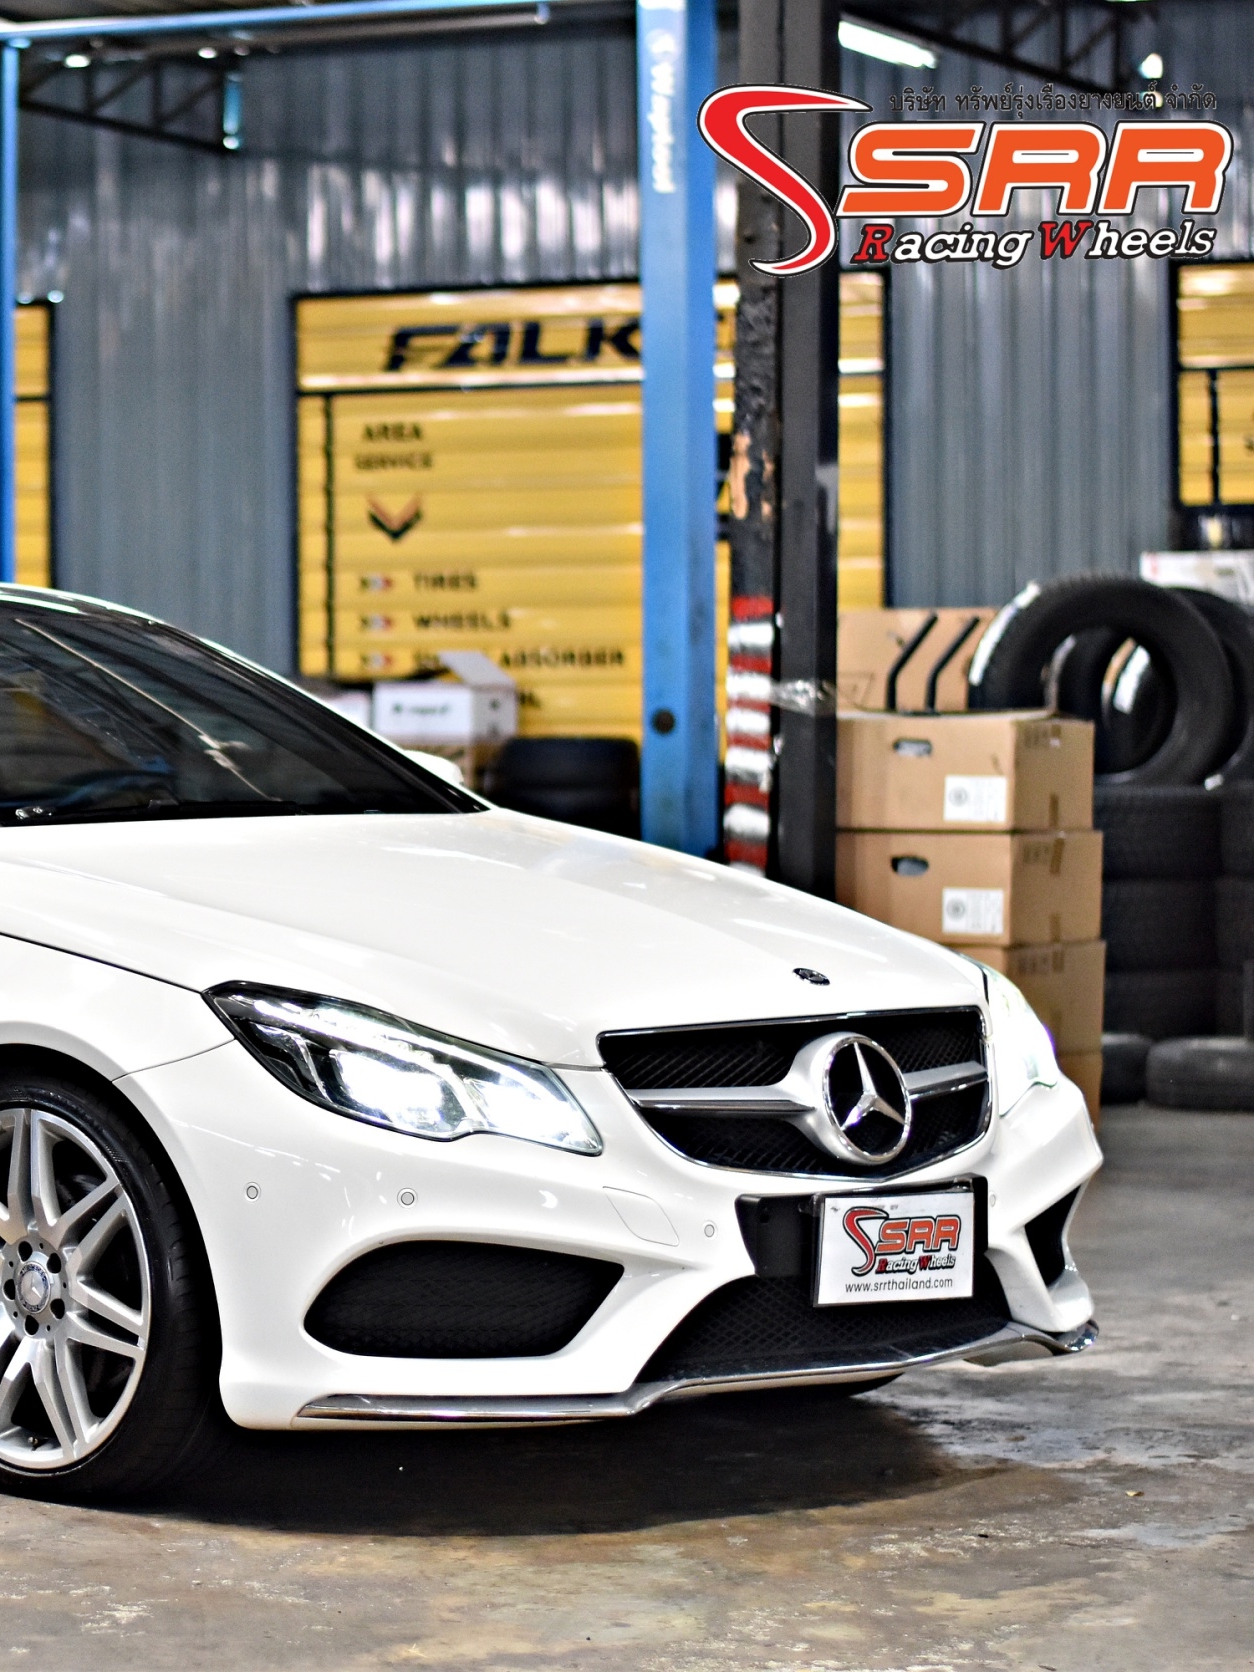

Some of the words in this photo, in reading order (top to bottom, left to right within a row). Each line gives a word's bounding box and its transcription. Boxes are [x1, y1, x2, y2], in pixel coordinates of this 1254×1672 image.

[362, 422, 422, 441] AREA
[413, 573, 477, 591] TIRES
[413, 609, 511, 629] WHEELS
[875, 1256, 919, 1275] Racing
[918, 1253, 956, 1271] Wheels
[845, 1277, 953, 1293] www.srrthailand.com
